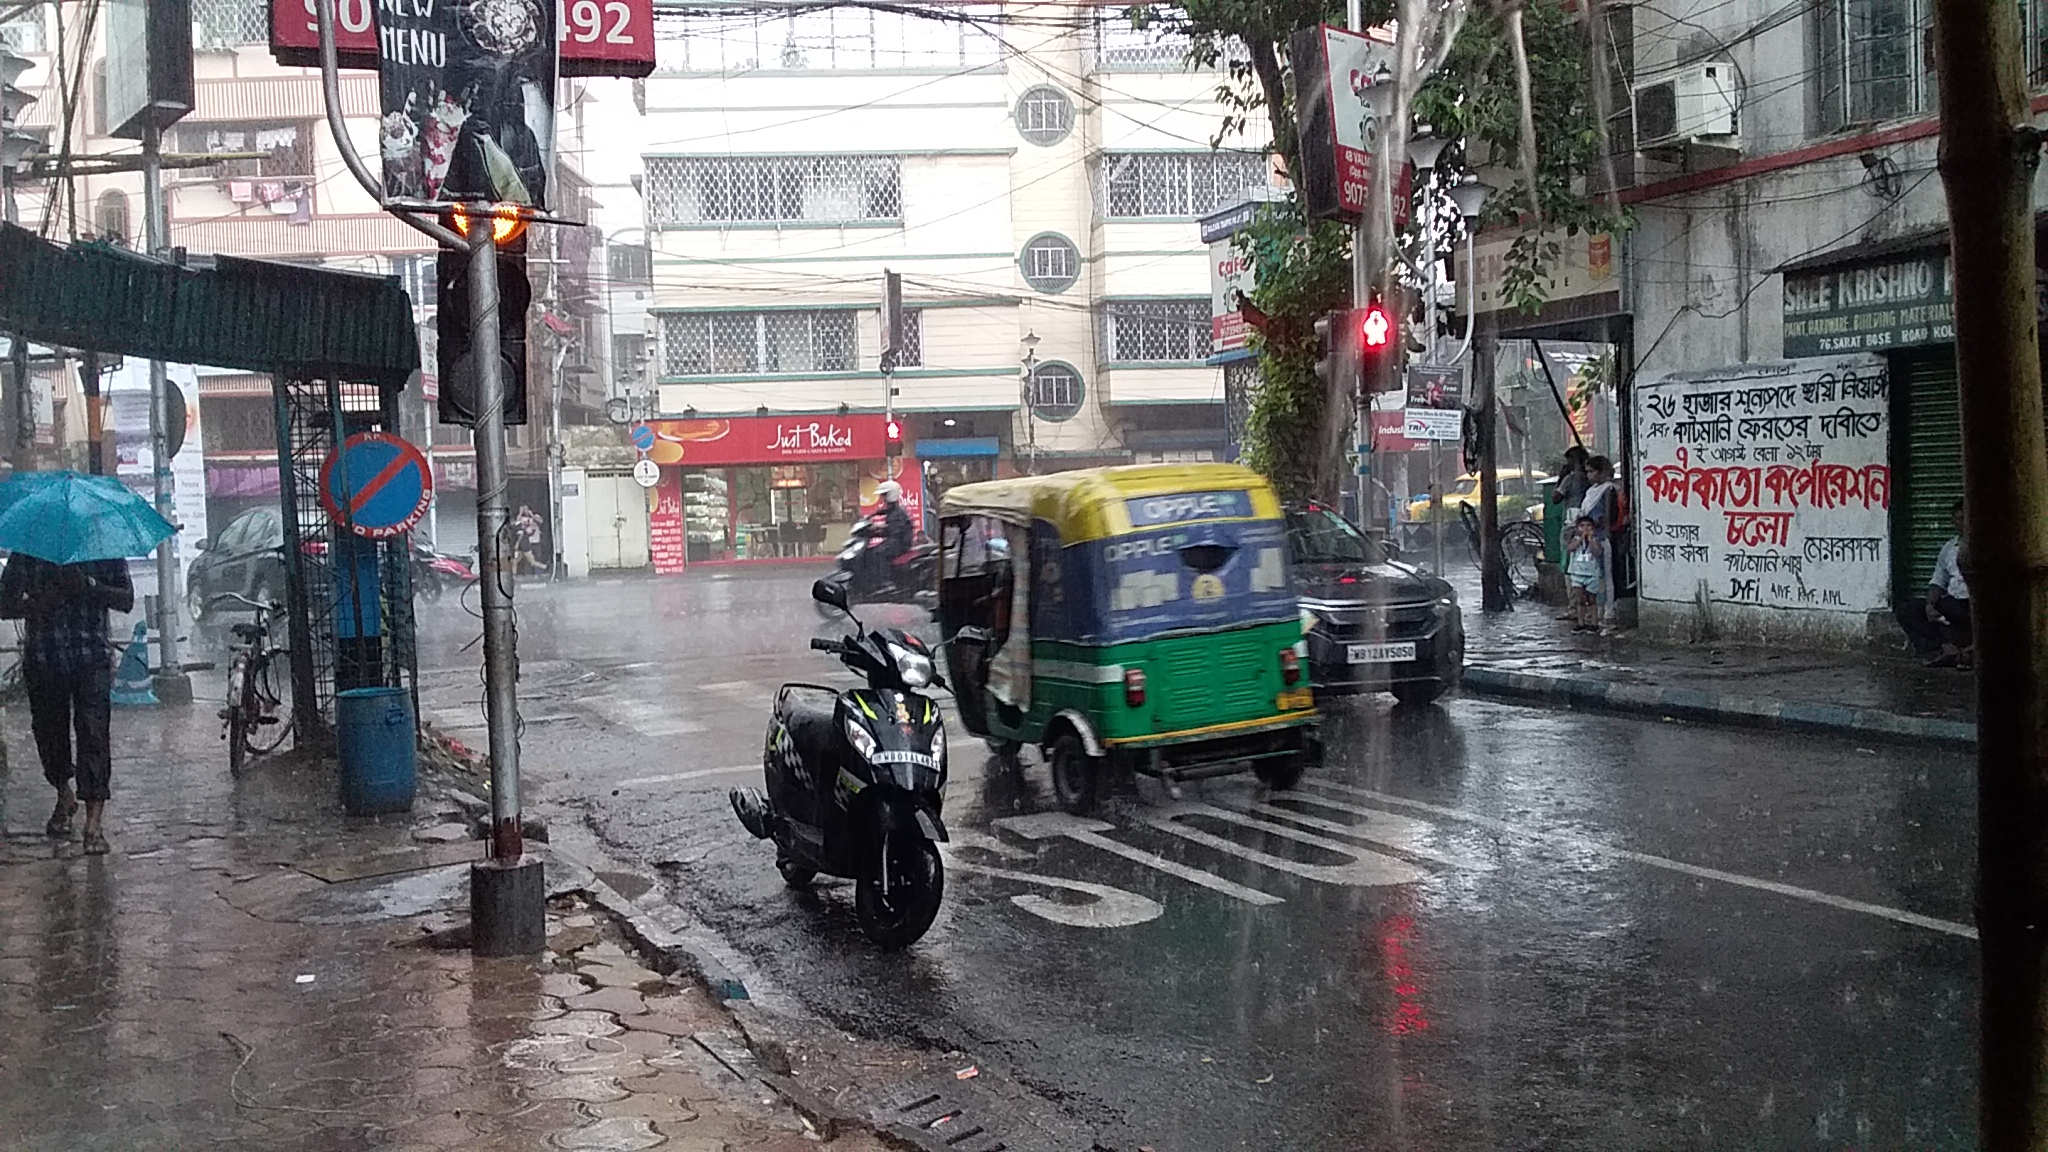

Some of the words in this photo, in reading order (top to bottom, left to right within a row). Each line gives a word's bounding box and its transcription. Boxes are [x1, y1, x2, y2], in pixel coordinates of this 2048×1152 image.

[380, 24, 447, 68] MENU
[1838, 260, 1934, 307] KRISHNO
[1853, 310, 1896, 332] BUILDING
[1866, 332, 1892, 346] BOSE
[1902, 328, 1928, 343] ROAD
[1682, 390, 1734, 416] হাজার
[767, 423, 809, 450] Just
[809, 422, 852, 448] Baked
[1673, 413, 1734, 445] কাটমানি
[1737, 415, 1813, 441] ফেরতের
[1754, 446, 1781, 463] বেলা
[1643, 464, 1762, 511] কলকাতা
[1764, 459, 1890, 510] কর্পোরেশন
[372, 488, 432, 538] PARKING
[1142, 495, 1221, 519] OPPLE
[1665, 524, 1700, 543] হাজার
[1723, 511, 1795, 548] চলো
[1103, 535, 1175, 562] OPPLE
[1645, 544, 1676, 564] চেয়ার
[1723, 549, 1778, 573] কাটমানি
